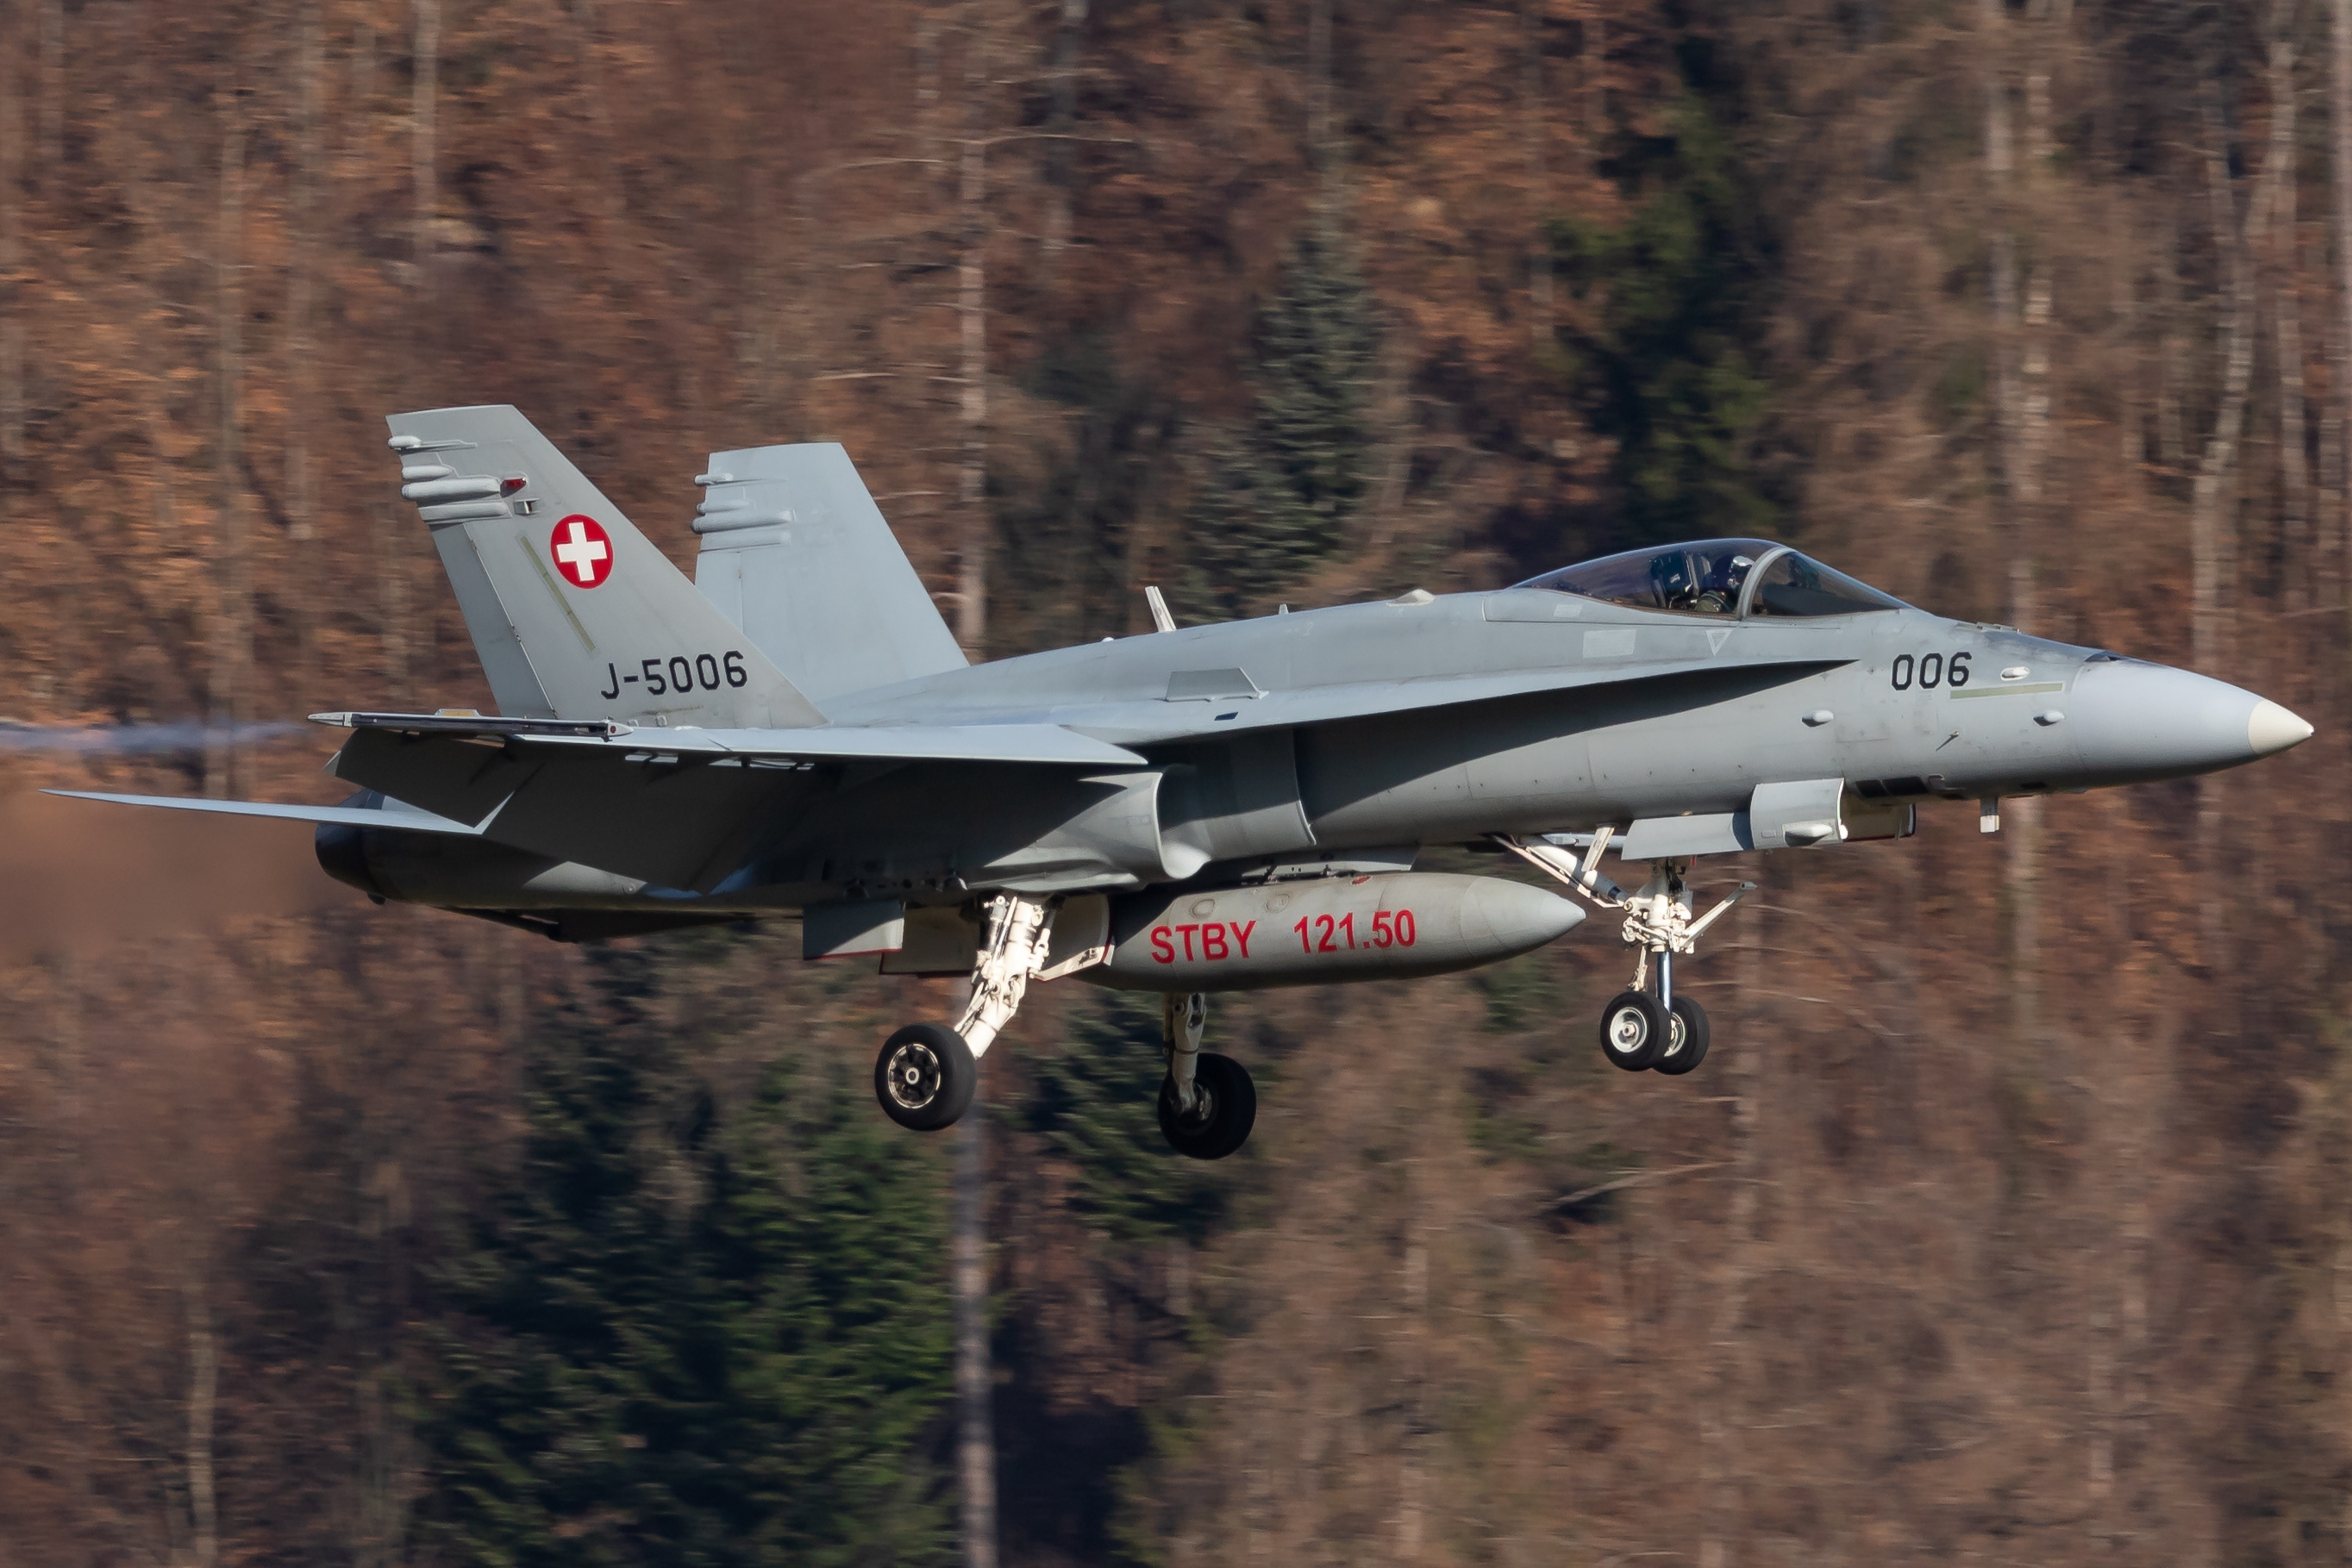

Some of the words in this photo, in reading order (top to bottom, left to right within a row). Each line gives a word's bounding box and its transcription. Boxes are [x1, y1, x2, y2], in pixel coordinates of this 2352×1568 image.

[600, 650, 748, 700] J-5006
[1891, 652, 1973, 691] 006
[1149, 919, 1257, 965] STBY
[1293, 909, 1417, 954] 121.50
